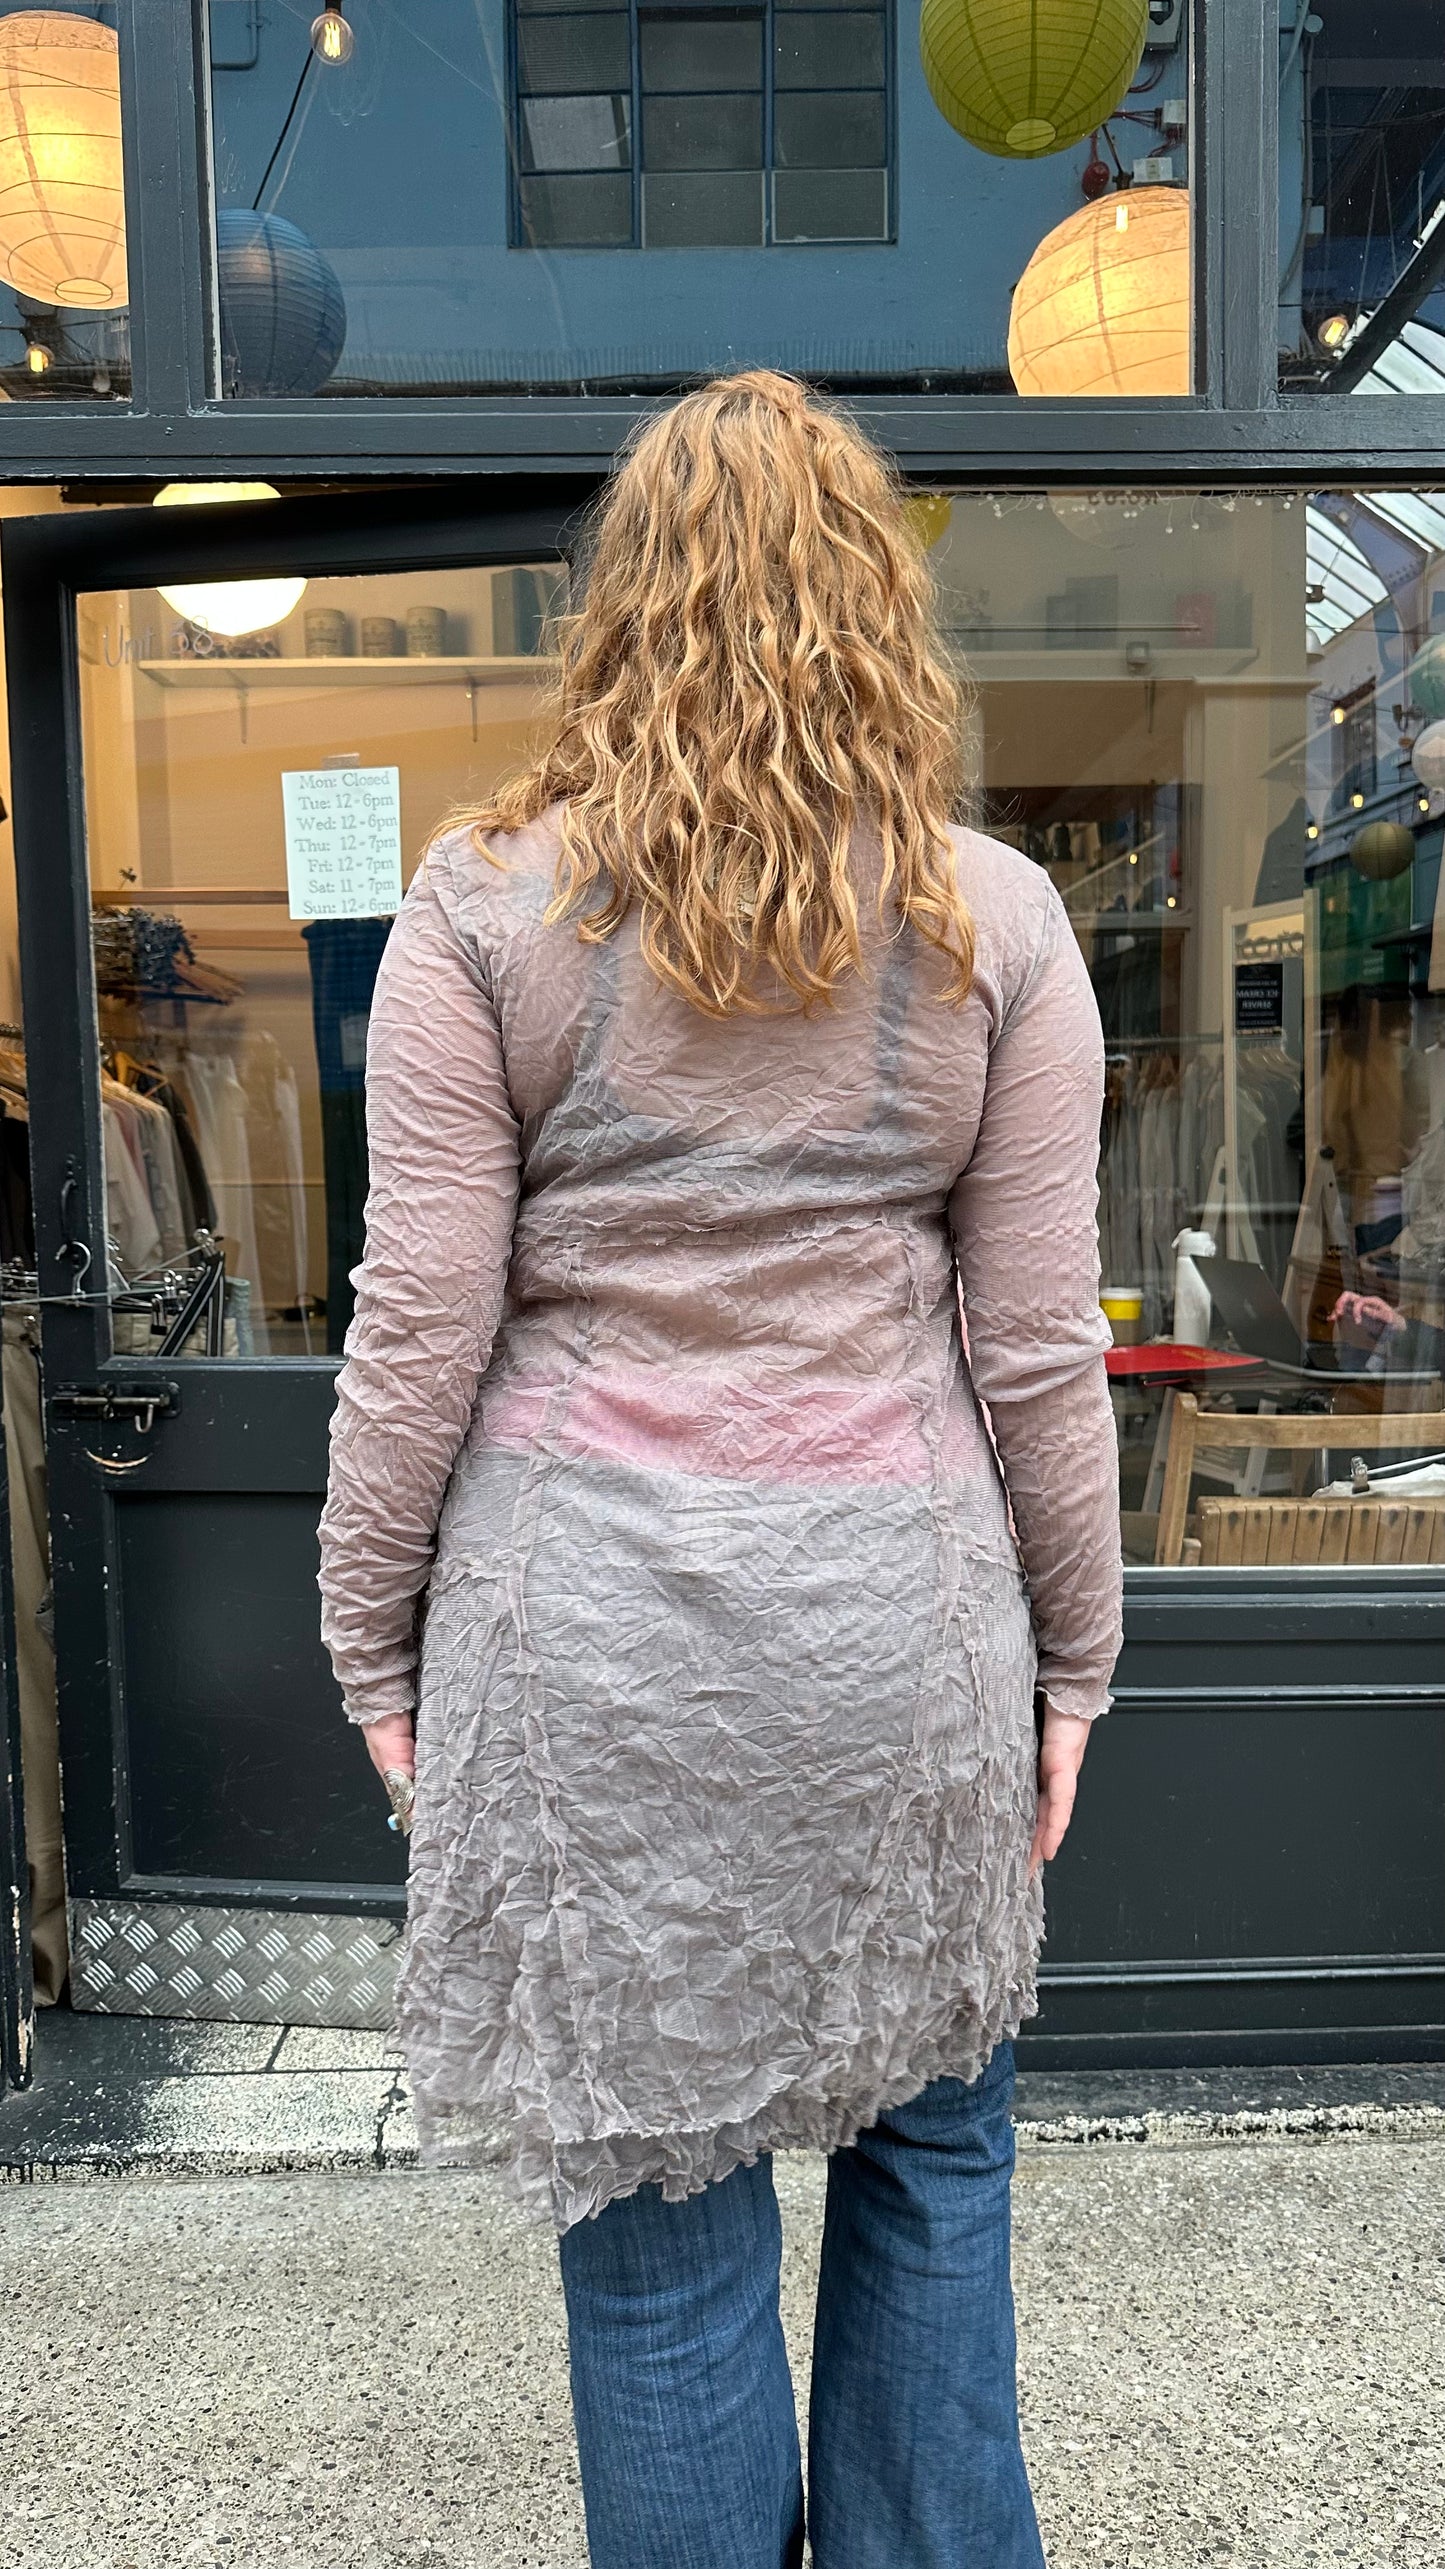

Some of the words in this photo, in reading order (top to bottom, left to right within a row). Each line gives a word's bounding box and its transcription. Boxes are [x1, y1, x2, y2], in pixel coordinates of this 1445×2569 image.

[300, 775, 337, 789] Mon:
[342, 771, 390, 787] Closed
[298, 796, 331, 810] Tue:
[336, 793, 352, 808] 12
[363, 793, 394, 810] 6pm
[296, 816, 336, 831] Wed:
[341, 814, 357, 829] 12
[367, 813, 397, 832] 6pm
[294, 838, 331, 852] Thu:
[340, 834, 357, 850] 12
[368, 835, 397, 853] 7pm
[308, 859, 333, 872] Fri:
[338, 856, 354, 871] 12
[365, 857, 395, 874] 7pm
[308, 880, 335, 893] Sat:
[341, 879, 353, 892] 11
[368, 877, 395, 894] 7pm
[303, 900, 336, 914] Sun:
[342, 898, 357, 913] 12
[369, 898, 397, 915] 6pm
